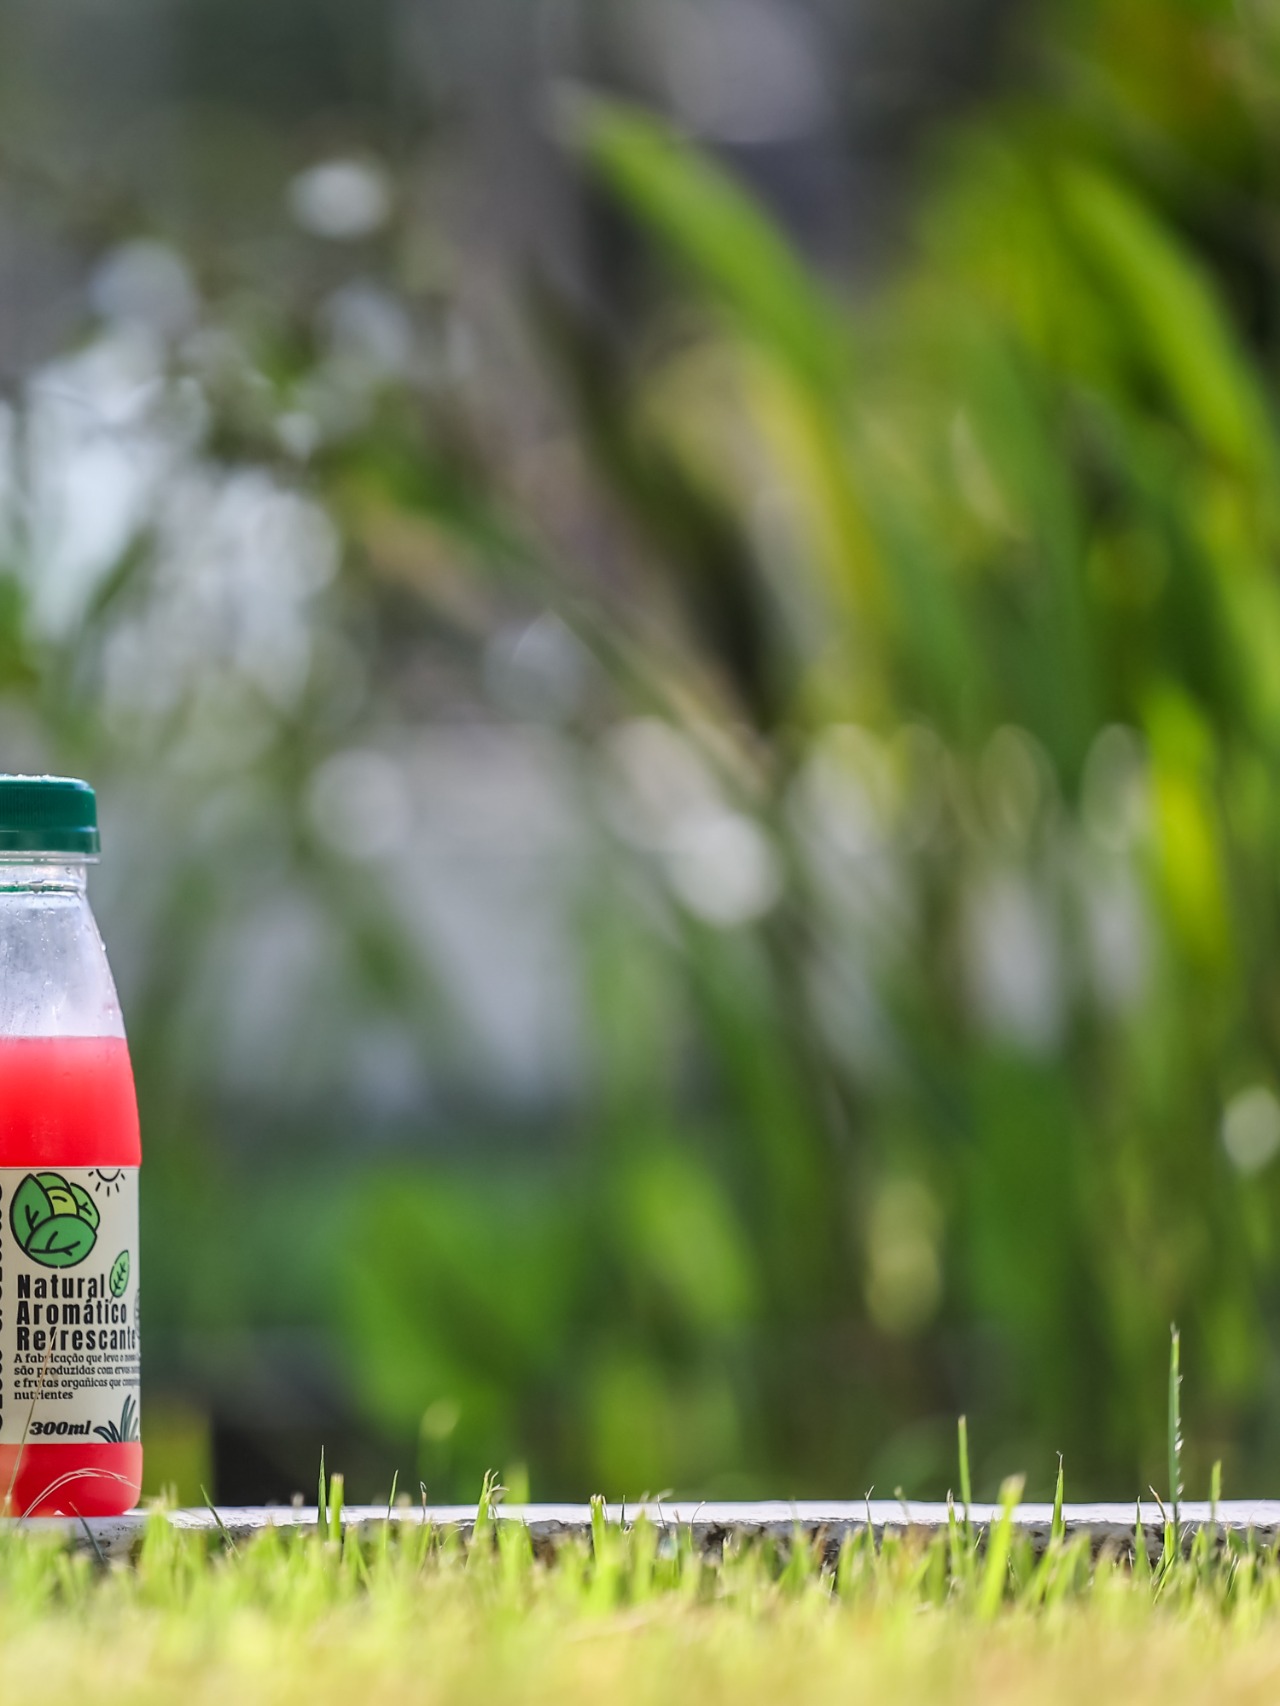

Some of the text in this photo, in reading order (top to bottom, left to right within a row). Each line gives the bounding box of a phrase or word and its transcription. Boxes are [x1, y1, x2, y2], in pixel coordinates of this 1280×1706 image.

[17, 1274, 104, 1299] Natural
[17, 1298, 127, 1325] Aromático
[17, 1326, 135, 1350] Refrescante
[14, 1354, 22, 1363] A
[86, 1355, 102, 1365] que
[104, 1353, 118, 1362] leva
[14, 1366, 34, 1375] são
[37, 1365, 95, 1377] produzidas
[97, 1367, 113, 1375] com
[23, 1378, 58, 1388] frutas
[30, 1421, 91, 1436] 300ml
